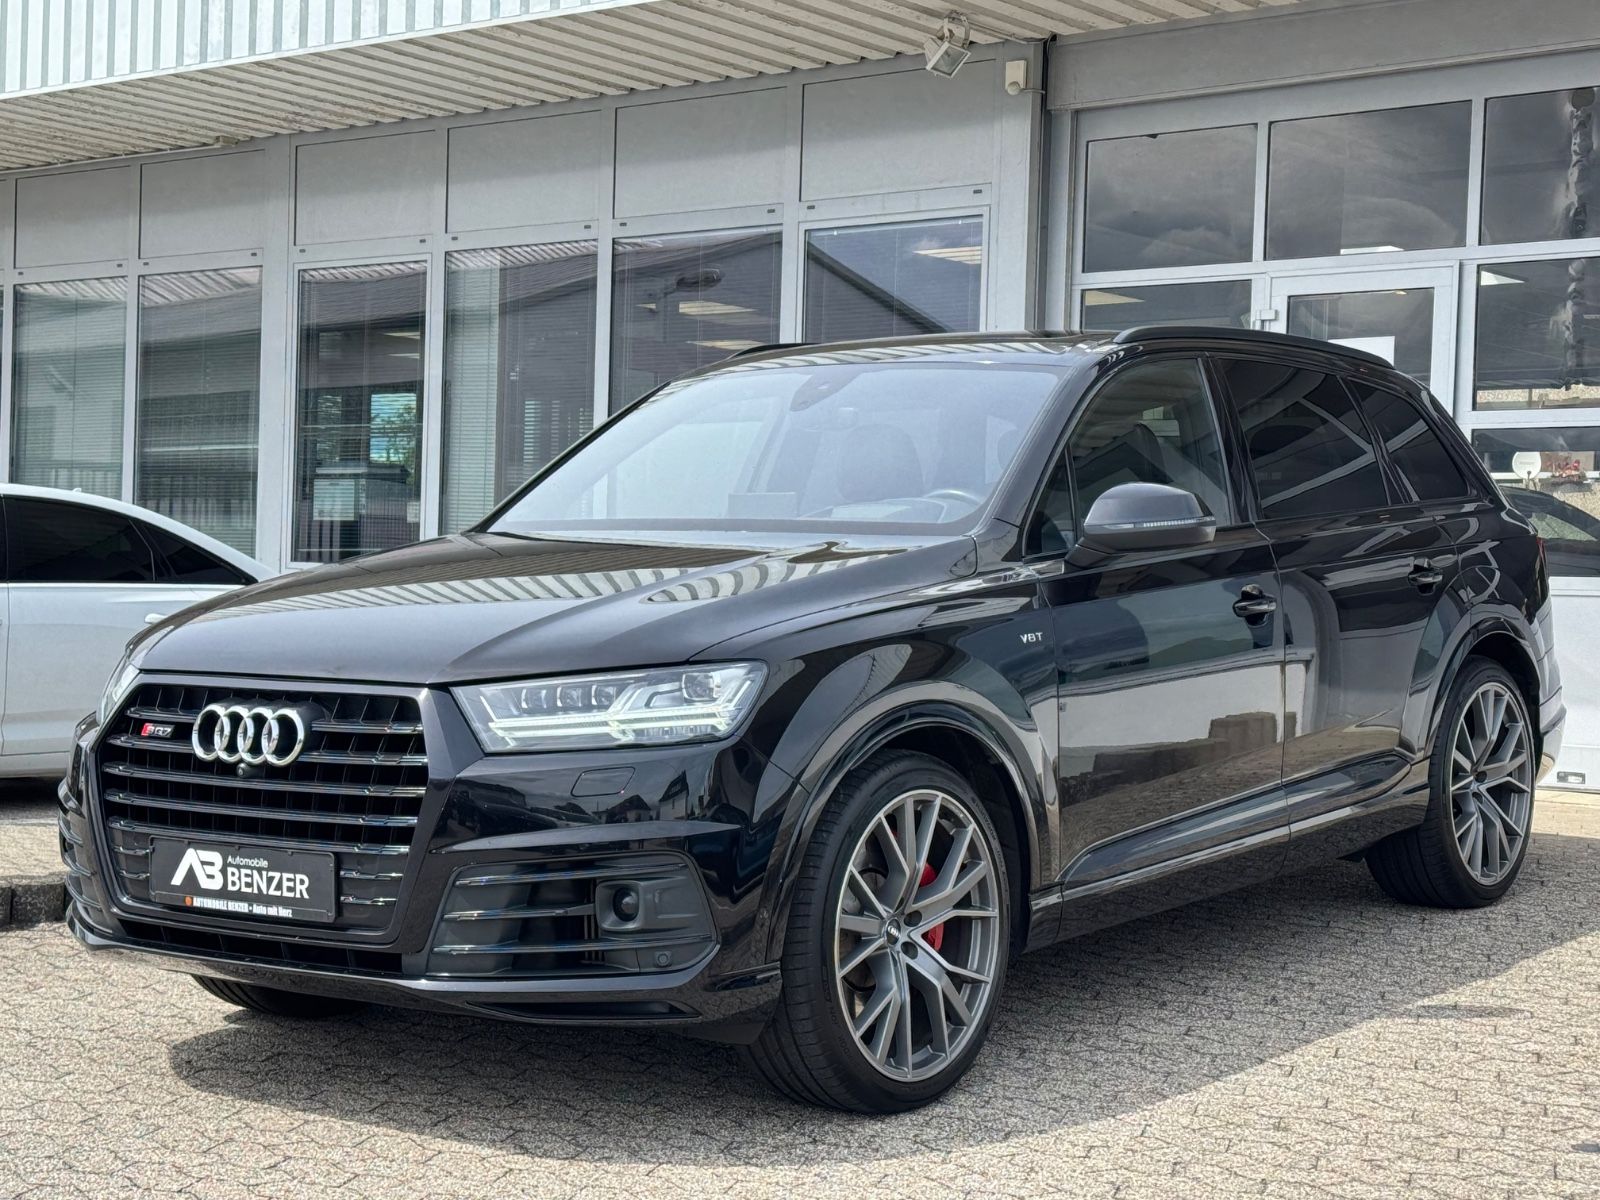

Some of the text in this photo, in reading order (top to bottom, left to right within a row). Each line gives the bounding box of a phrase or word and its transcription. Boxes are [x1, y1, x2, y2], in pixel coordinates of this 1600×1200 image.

[1020, 632, 1043, 643] V8T
[226, 855, 269, 869] Automobile
[226, 866, 310, 900] BENZER
[193, 897, 227, 910] AUTOMOBILE
[227, 901, 249, 913] BENZER
